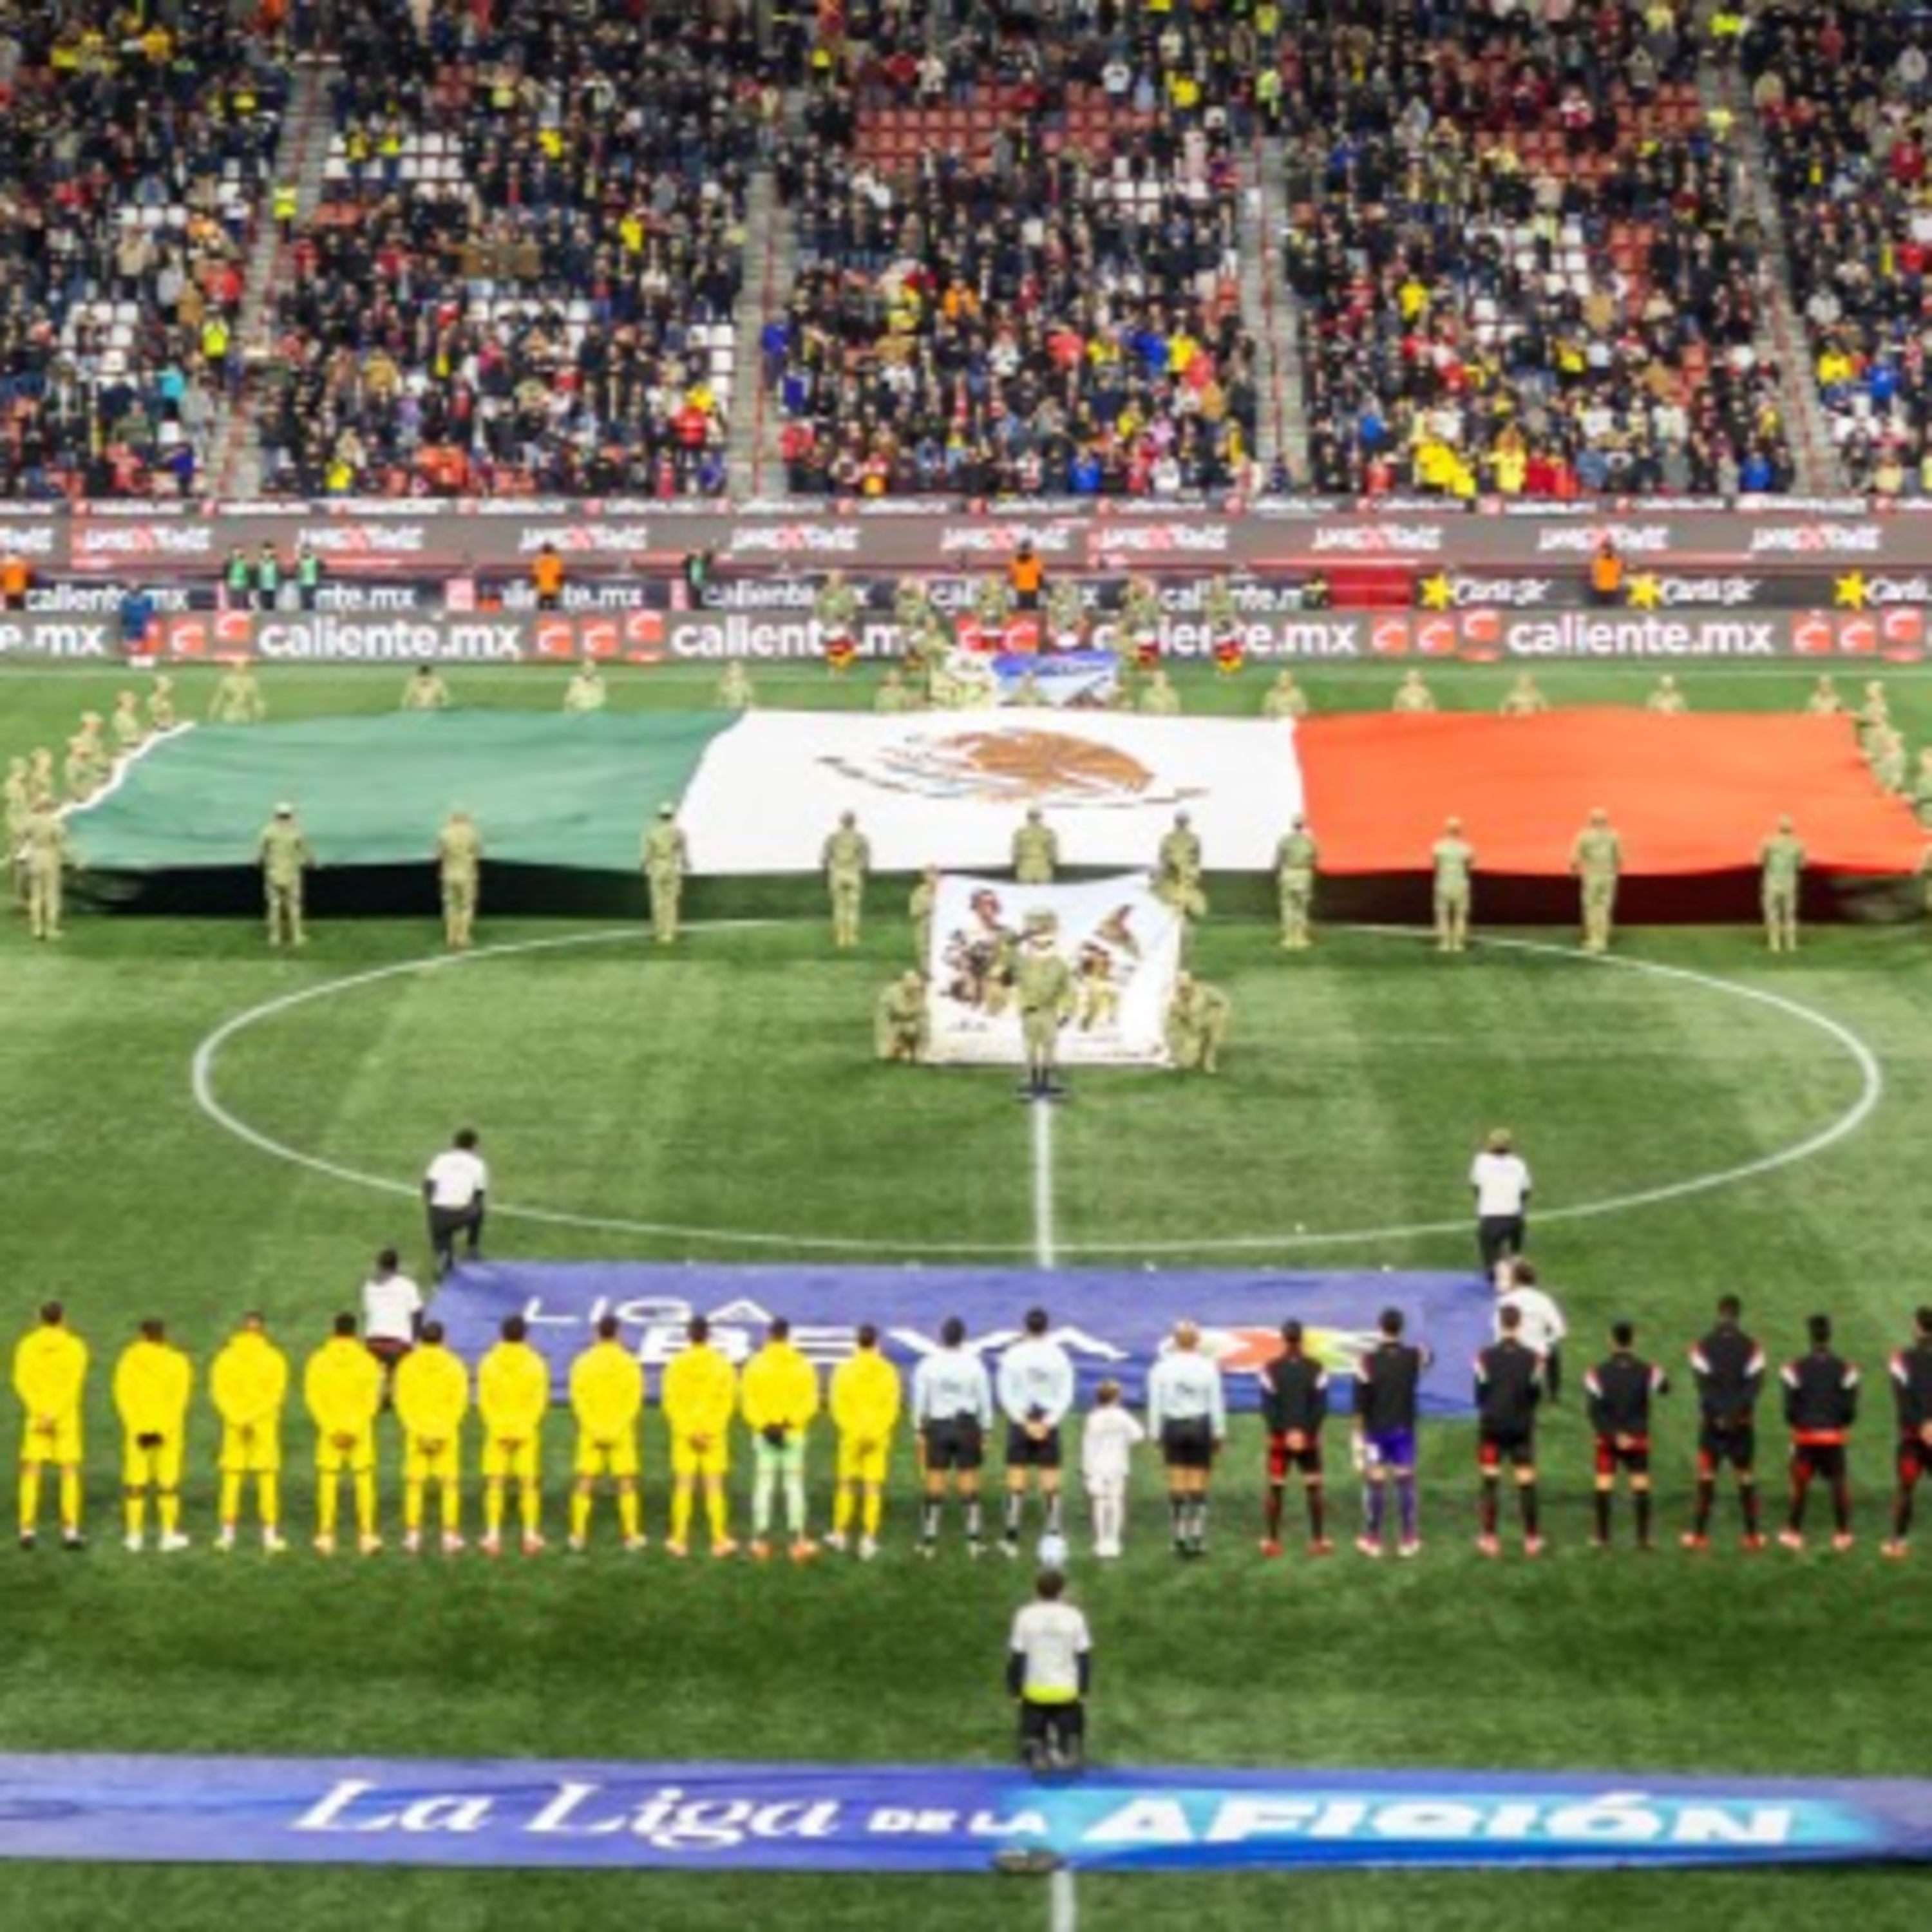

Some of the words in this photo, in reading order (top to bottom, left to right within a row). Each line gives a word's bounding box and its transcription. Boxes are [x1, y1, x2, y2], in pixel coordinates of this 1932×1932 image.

[259, 613, 522, 658] caliente.mx
[1508, 613, 1775, 658] caliente.mx
[288, 1778, 495, 1832] La
[523, 1780, 840, 1850] Liga
[867, 1807, 958, 1833] DE
[968, 1809, 1048, 1835] LA
